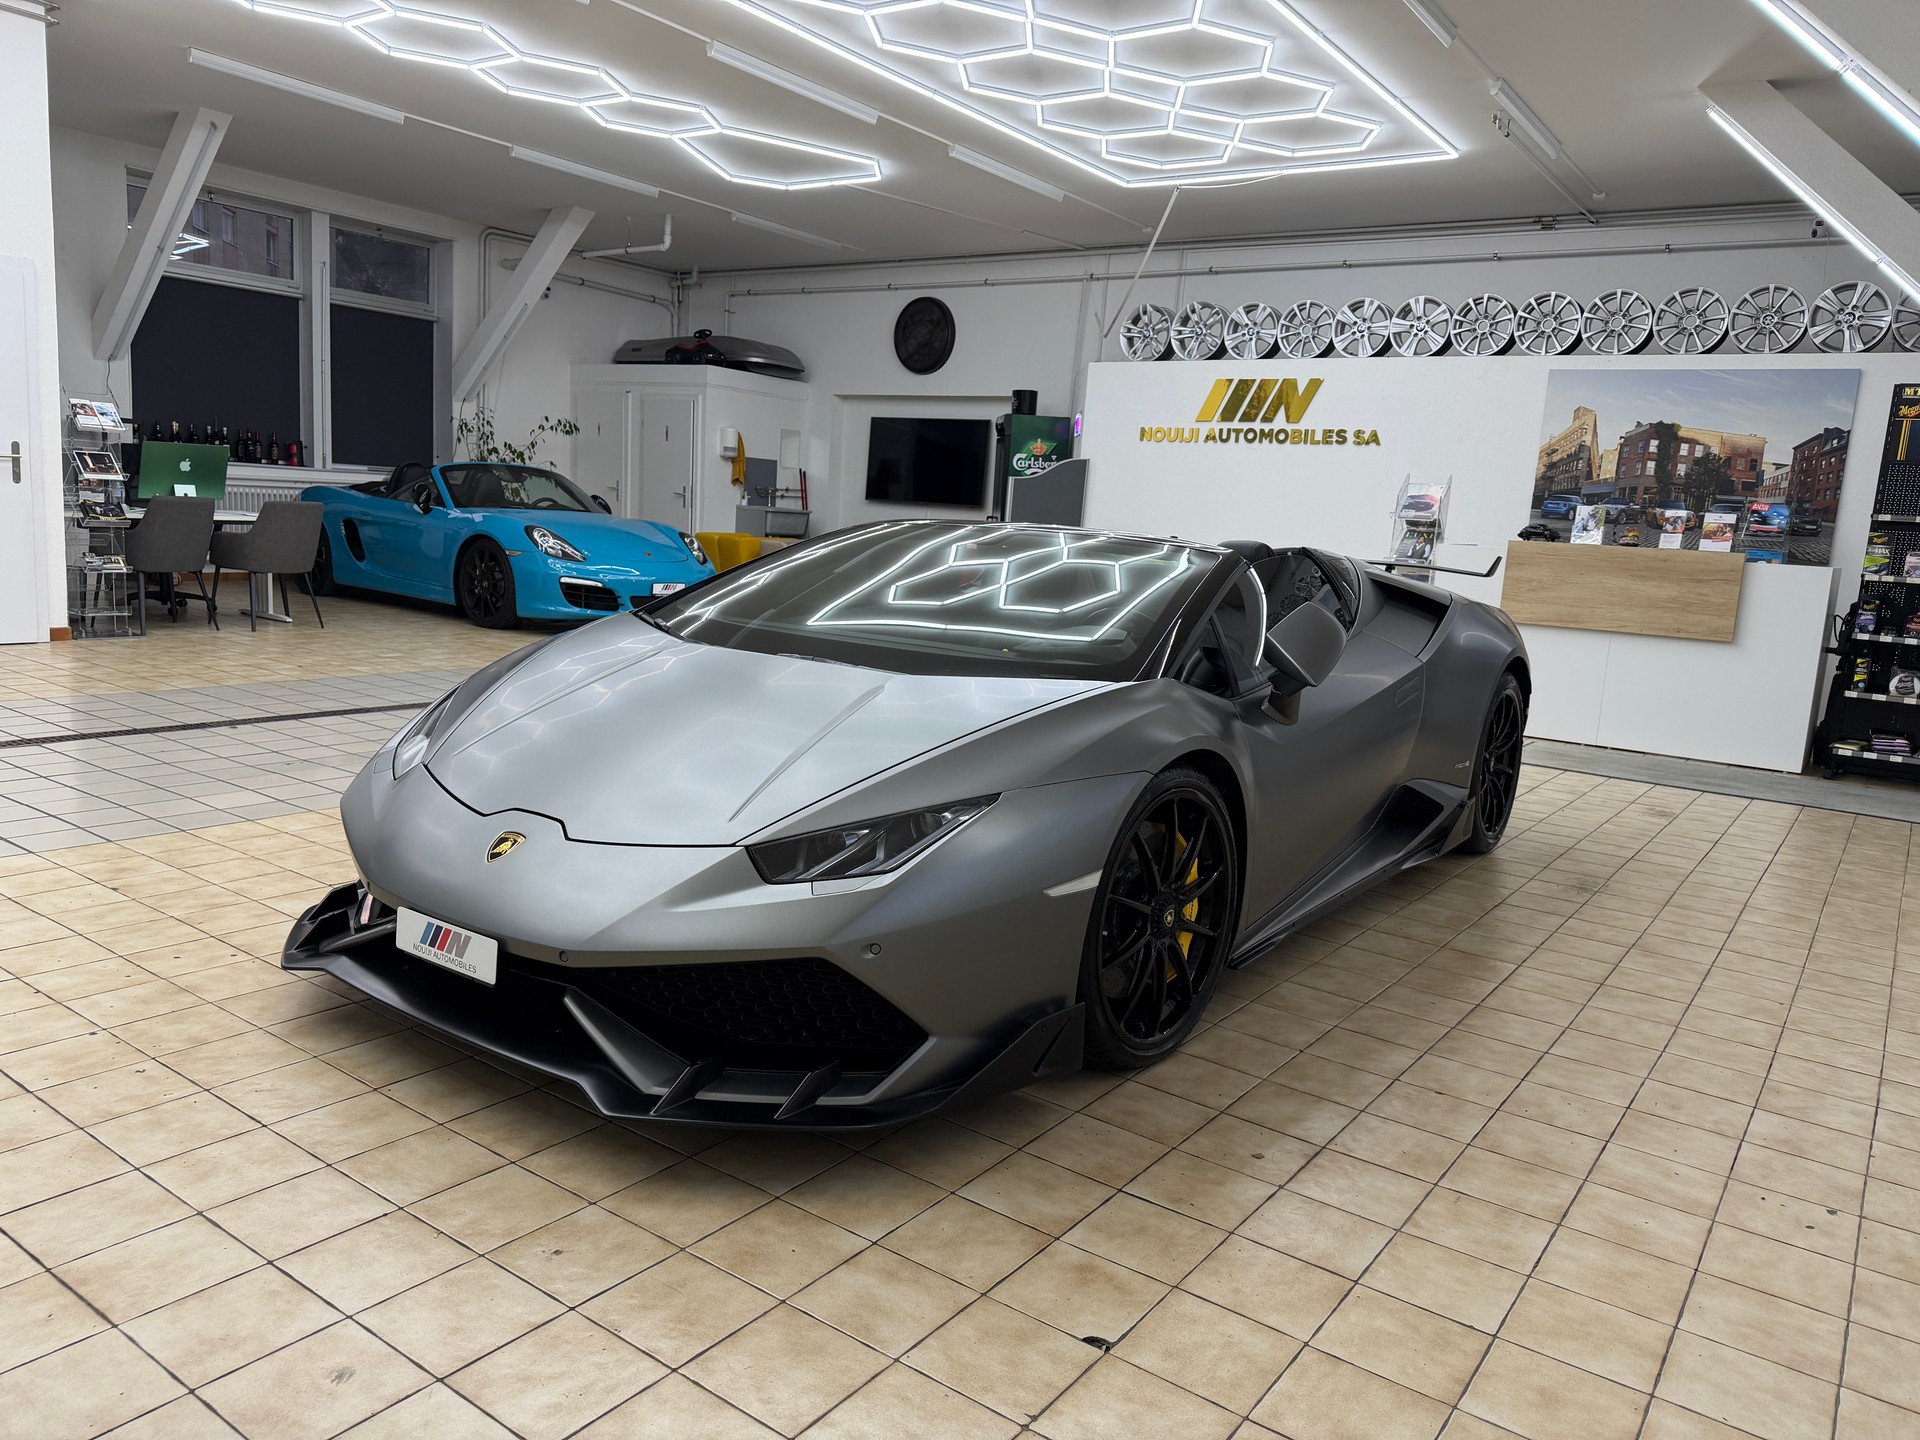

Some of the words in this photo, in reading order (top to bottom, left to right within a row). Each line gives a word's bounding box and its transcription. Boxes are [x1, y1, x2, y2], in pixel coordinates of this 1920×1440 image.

[1140, 427, 1199, 443] NOUIJI
[1204, 428, 1347, 445] AUTOMOBILES
[1353, 430, 1381, 446] SA
[1013, 453, 1057, 471] Carlsber
[433, 951, 477, 973] AUTOMOBILES
